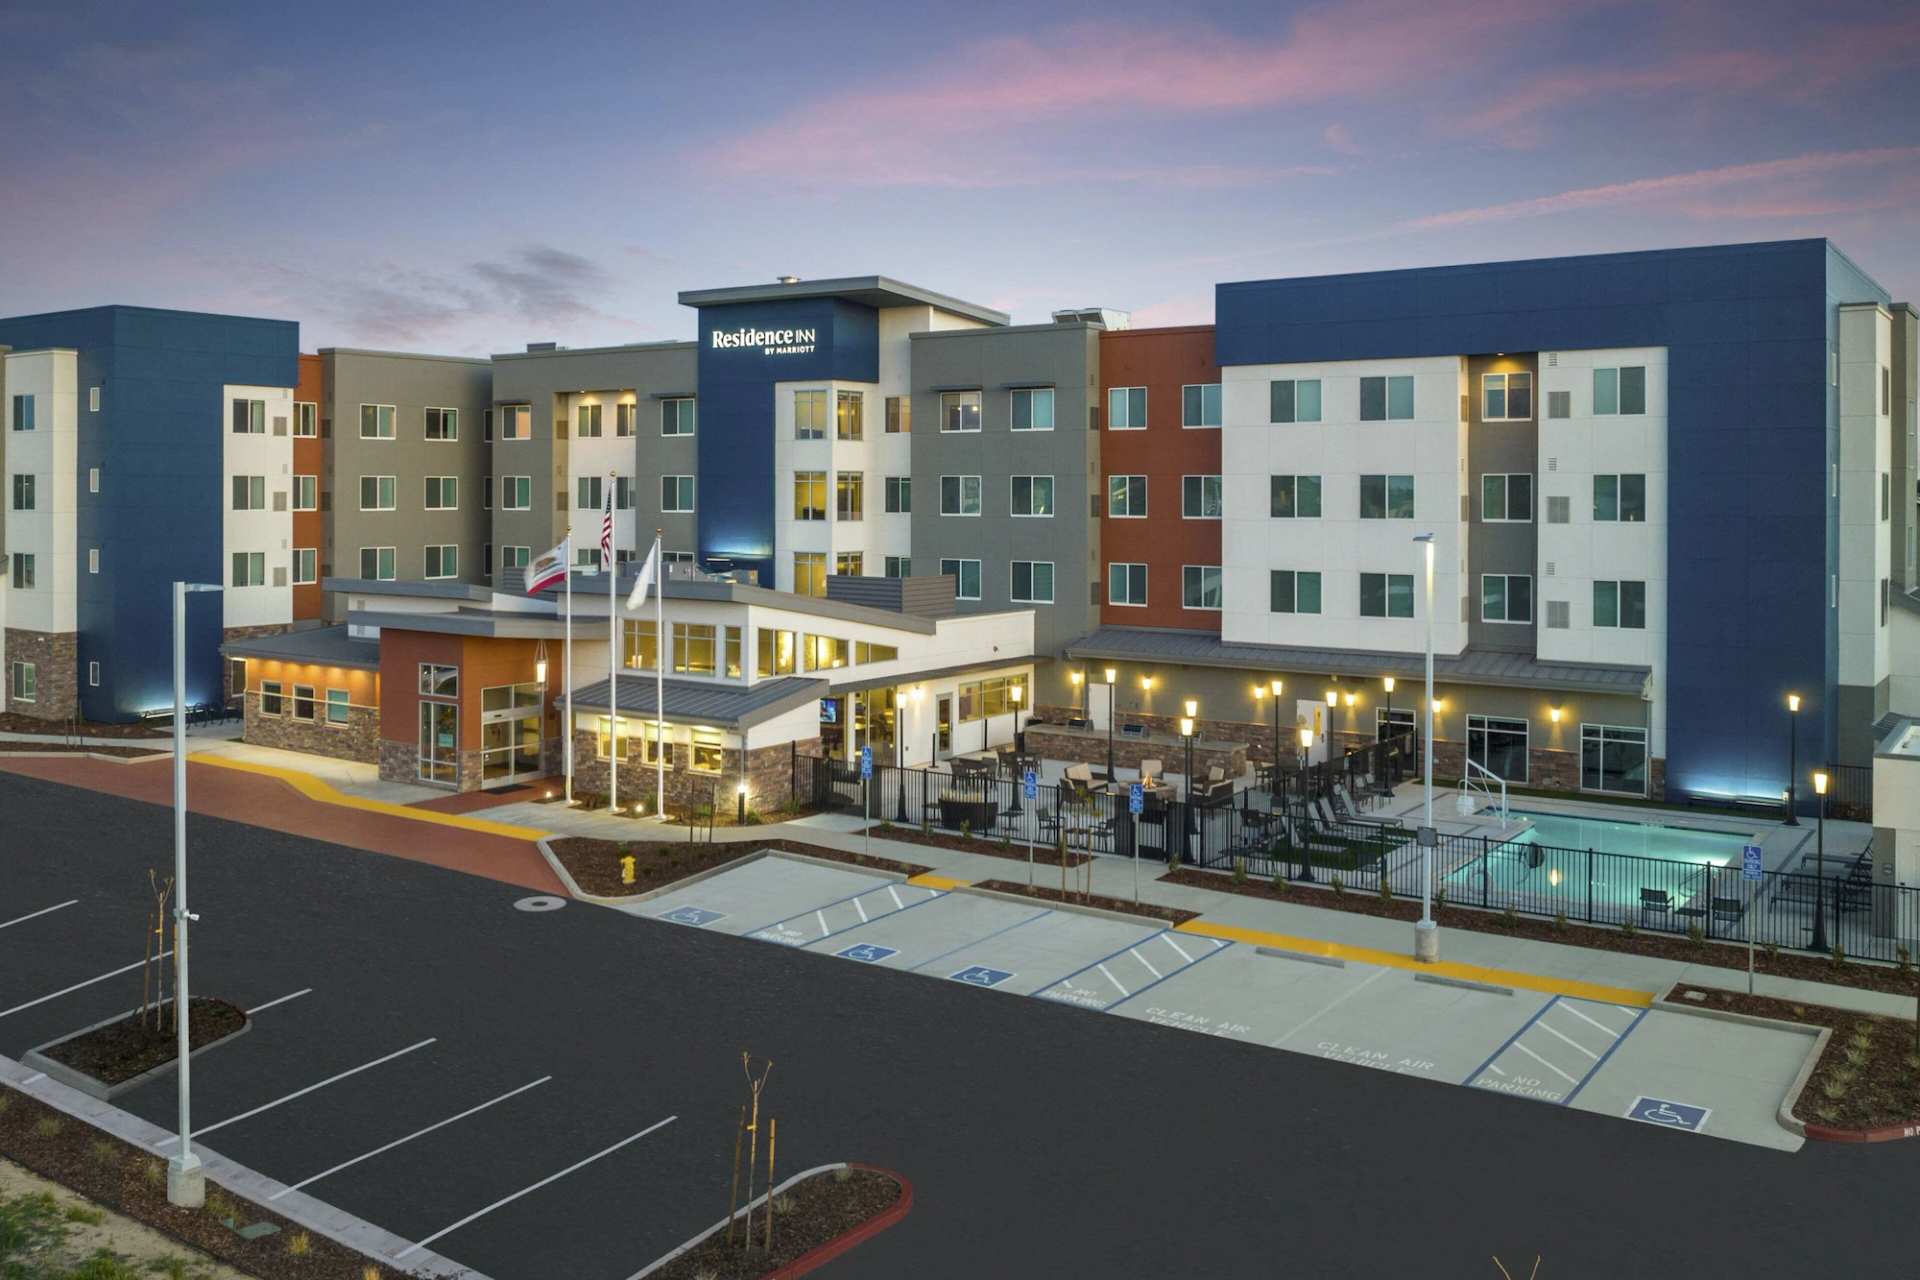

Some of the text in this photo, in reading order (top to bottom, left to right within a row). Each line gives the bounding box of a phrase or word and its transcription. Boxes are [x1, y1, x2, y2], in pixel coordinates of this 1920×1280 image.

[712, 328, 816, 349] Residence INN
[764, 345, 815, 355] BY MARRIOTT
[1317, 1041, 1434, 1071] CLEAN AIR
[1477, 1079, 1562, 1101] PARKING
[1512, 1075, 1541, 1087] NO
